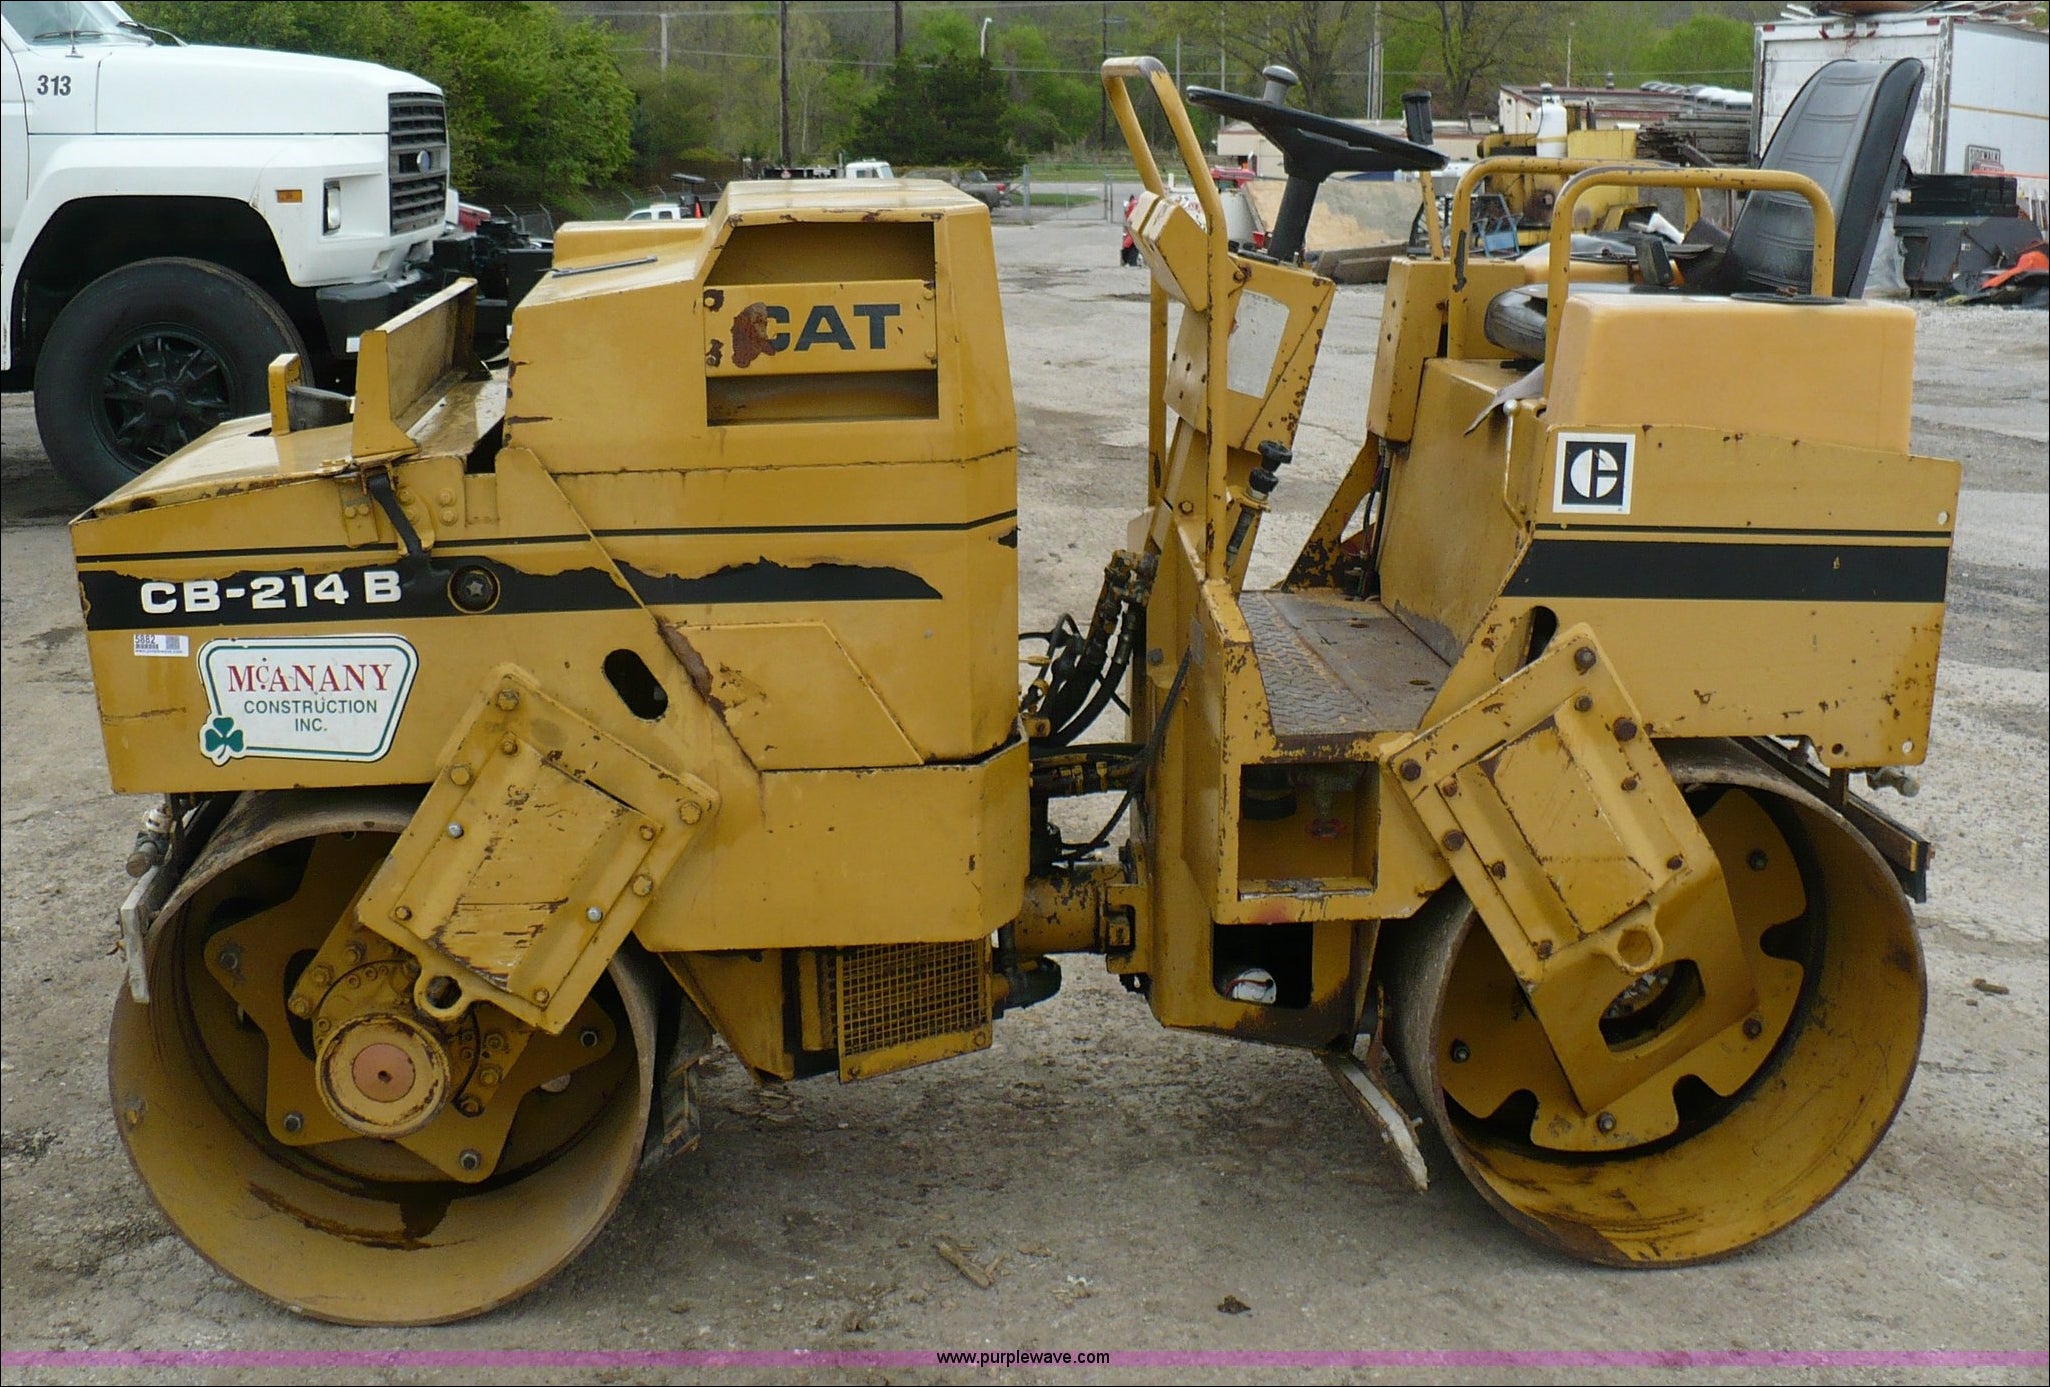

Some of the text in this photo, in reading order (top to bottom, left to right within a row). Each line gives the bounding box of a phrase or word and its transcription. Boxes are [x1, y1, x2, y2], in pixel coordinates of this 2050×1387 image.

[37, 74, 72, 97] 313
[140, 570, 402, 614] CB-214 B
[243, 699, 378, 714] CONSTRUCTION
[294, 718, 328, 732] INC.
